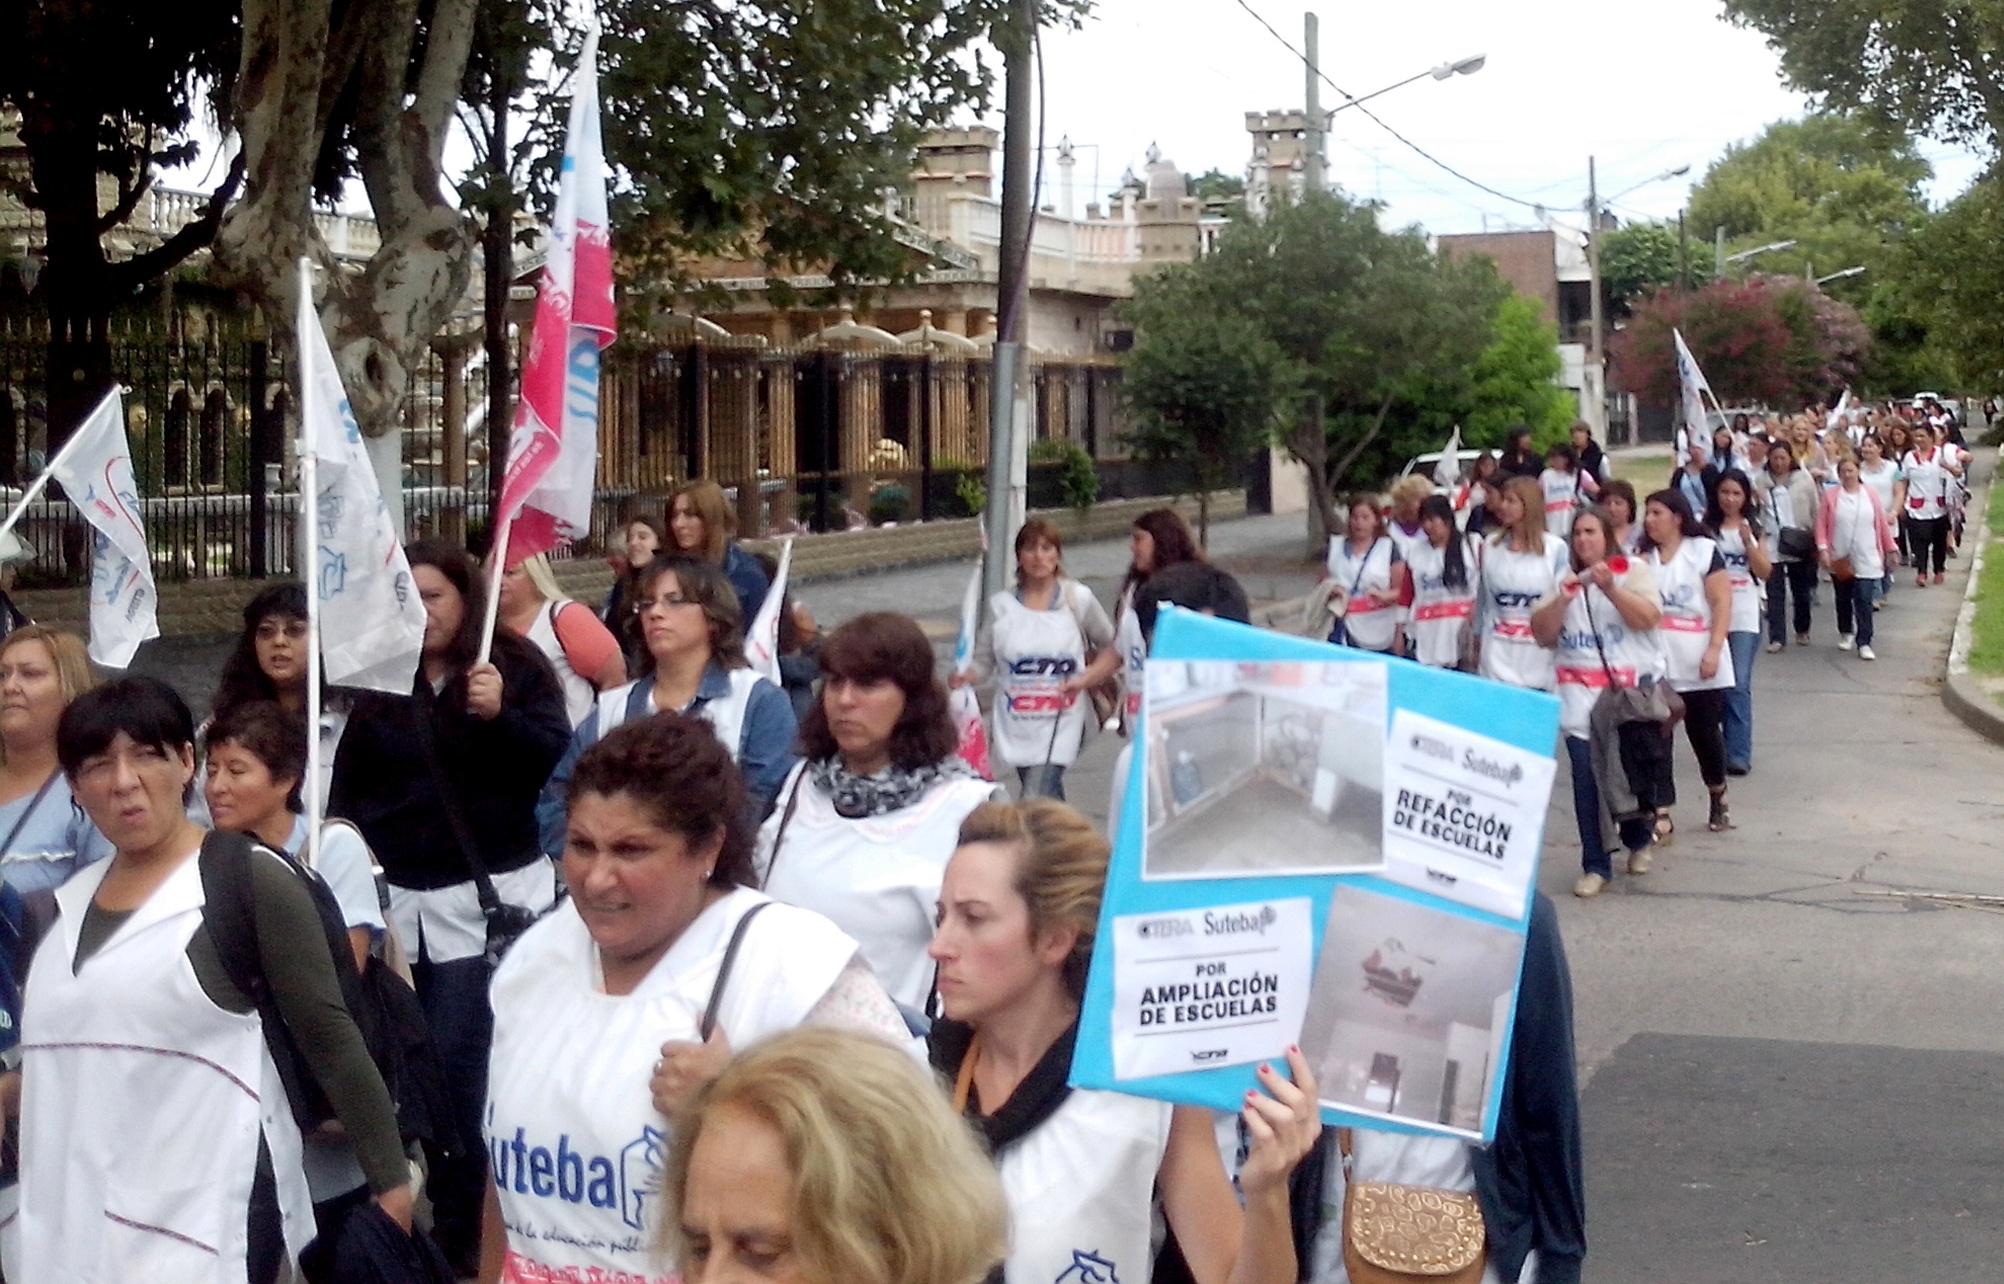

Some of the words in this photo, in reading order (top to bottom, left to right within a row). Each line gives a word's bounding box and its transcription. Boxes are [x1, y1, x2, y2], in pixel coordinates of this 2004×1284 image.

[1396, 788, 1511, 842] REFACCIÓN
[1393, 810, 1416, 830] DE
[1420, 819, 1506, 860] ESCUELAS
[1203, 910, 1263, 936] Suteba
[1195, 962, 1227, 978] POR
[1140, 971, 1279, 1007] AMPLIACIÓN
[1139, 1006, 1167, 1027] DE
[1173, 995, 1278, 1023] ESCUELAS
[488, 1101, 617, 1208] uteba
